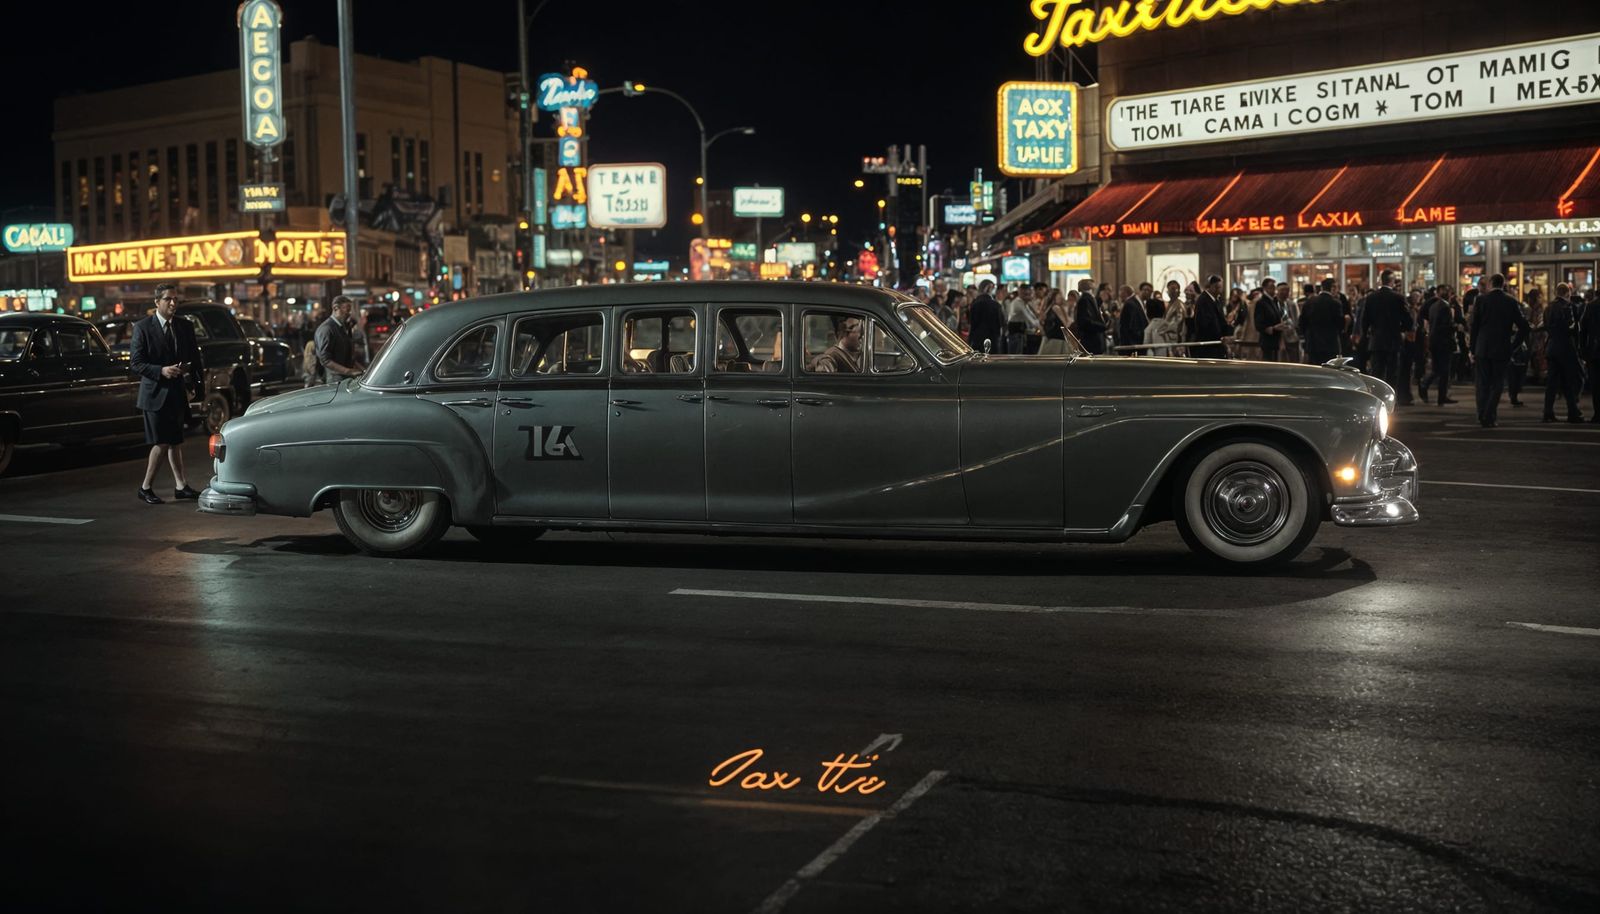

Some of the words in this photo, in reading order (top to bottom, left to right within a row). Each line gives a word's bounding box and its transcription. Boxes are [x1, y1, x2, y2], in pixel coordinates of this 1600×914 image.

[251, 4, 278, 139] AECOA
[1171, 95, 1226, 116] TIARE
[1427, 64, 1459, 86] OT
[1479, 49, 1571, 80] MAMIG
[1017, 98, 1064, 116] AOX
[1204, 113, 1264, 134] CAMA
[1410, 88, 1463, 113] TOM
[1012, 119, 1068, 140] TAXY
[170, 240, 225, 268] TAX
